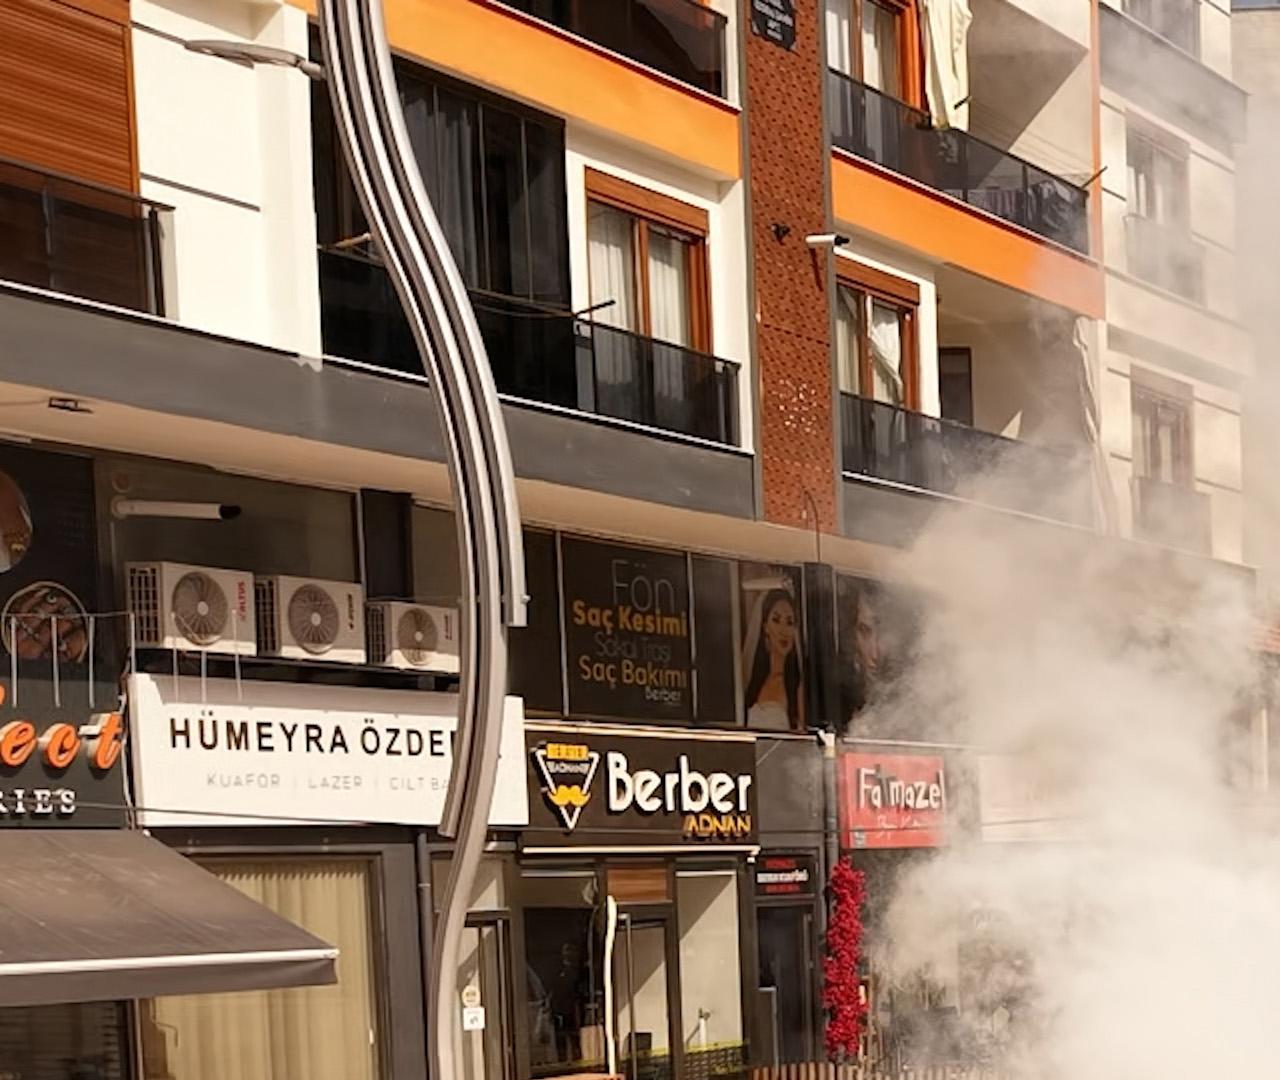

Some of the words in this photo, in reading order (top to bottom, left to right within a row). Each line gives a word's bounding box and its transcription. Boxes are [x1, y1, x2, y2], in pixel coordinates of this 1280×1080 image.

[572, 600, 613, 635] Saç
[618, 605, 688, 637] Kesimi
[578, 655, 617, 689] Saç
[622, 659, 688, 688] Bakımı
[170, 711, 349, 753] HÜMEYRA
[361, 719, 456, 757] ÖZDE
[308, 775, 362, 789] LAZER
[606, 751, 751, 813] Berber
[684, 814, 751, 834] ADNAN
